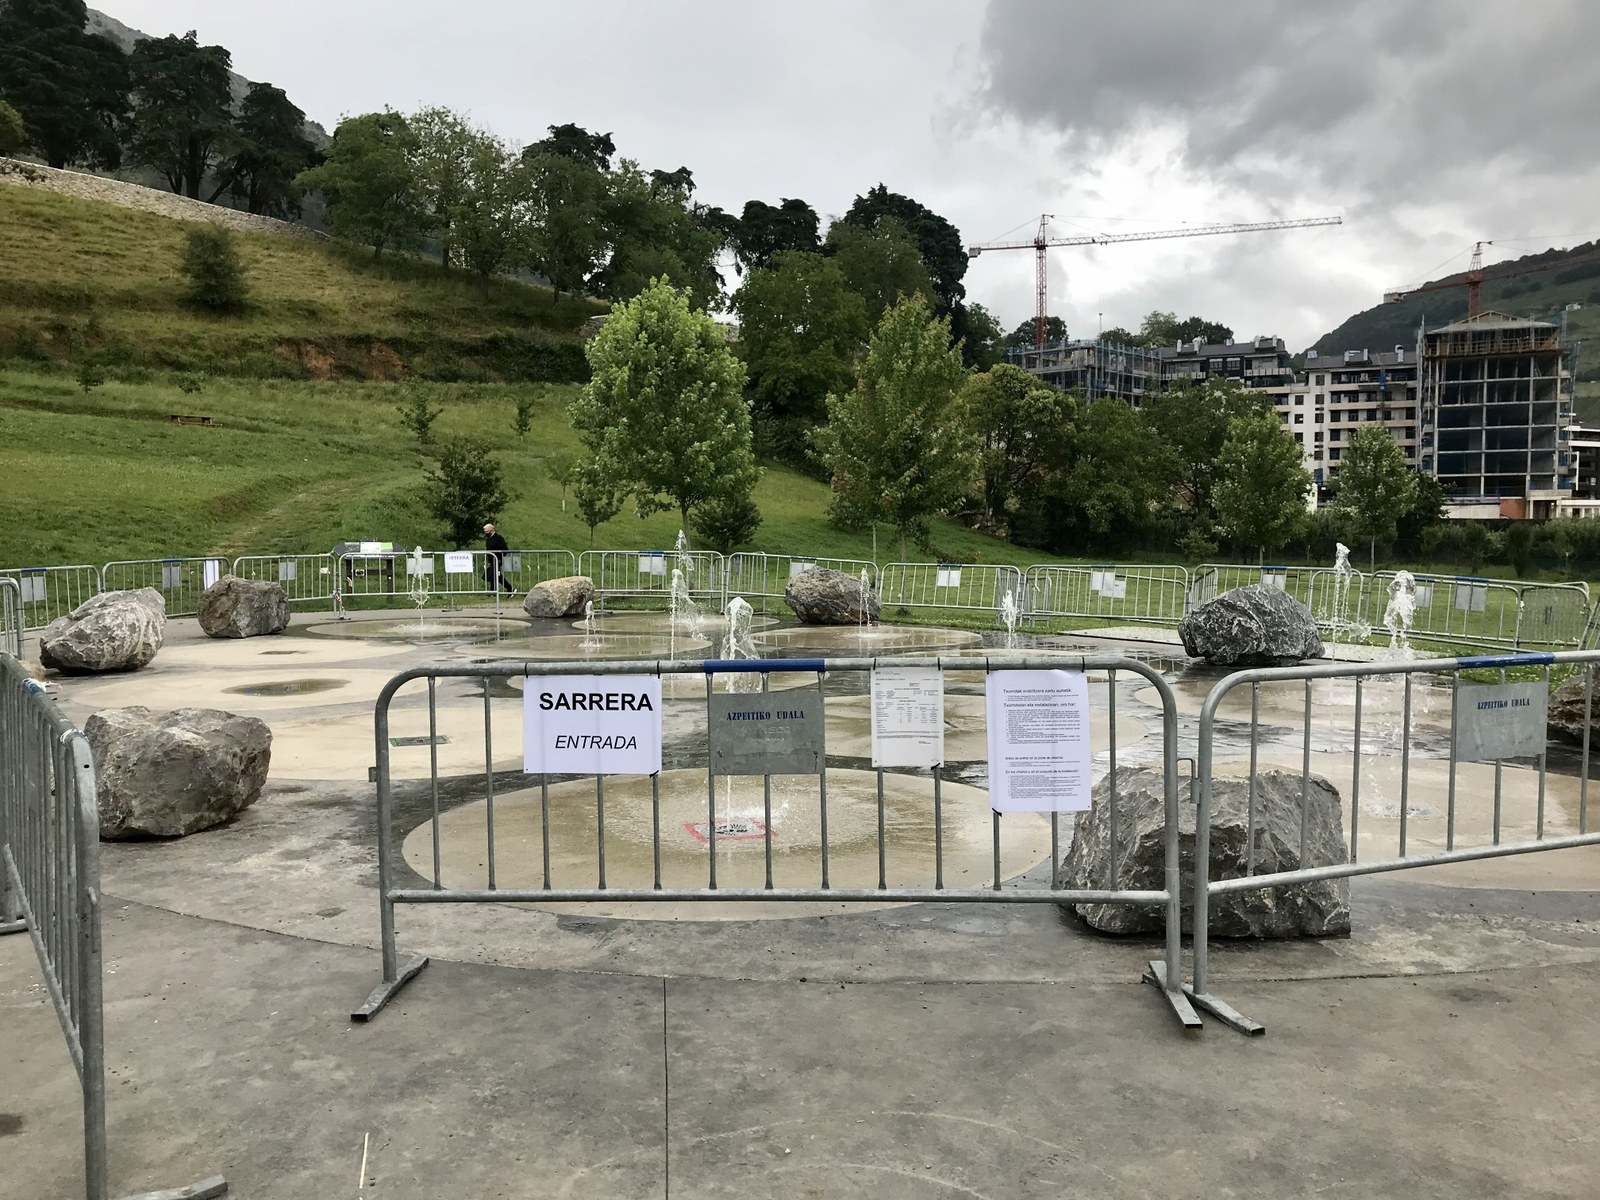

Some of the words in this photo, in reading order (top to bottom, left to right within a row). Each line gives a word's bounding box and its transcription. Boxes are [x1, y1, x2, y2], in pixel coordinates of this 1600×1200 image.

[539, 692, 653, 711] SARRERA
[726, 711, 771, 720] AZPEITIKO
[777, 710, 805, 719] UDALA
[555, 735, 637, 750] ENTRADA
